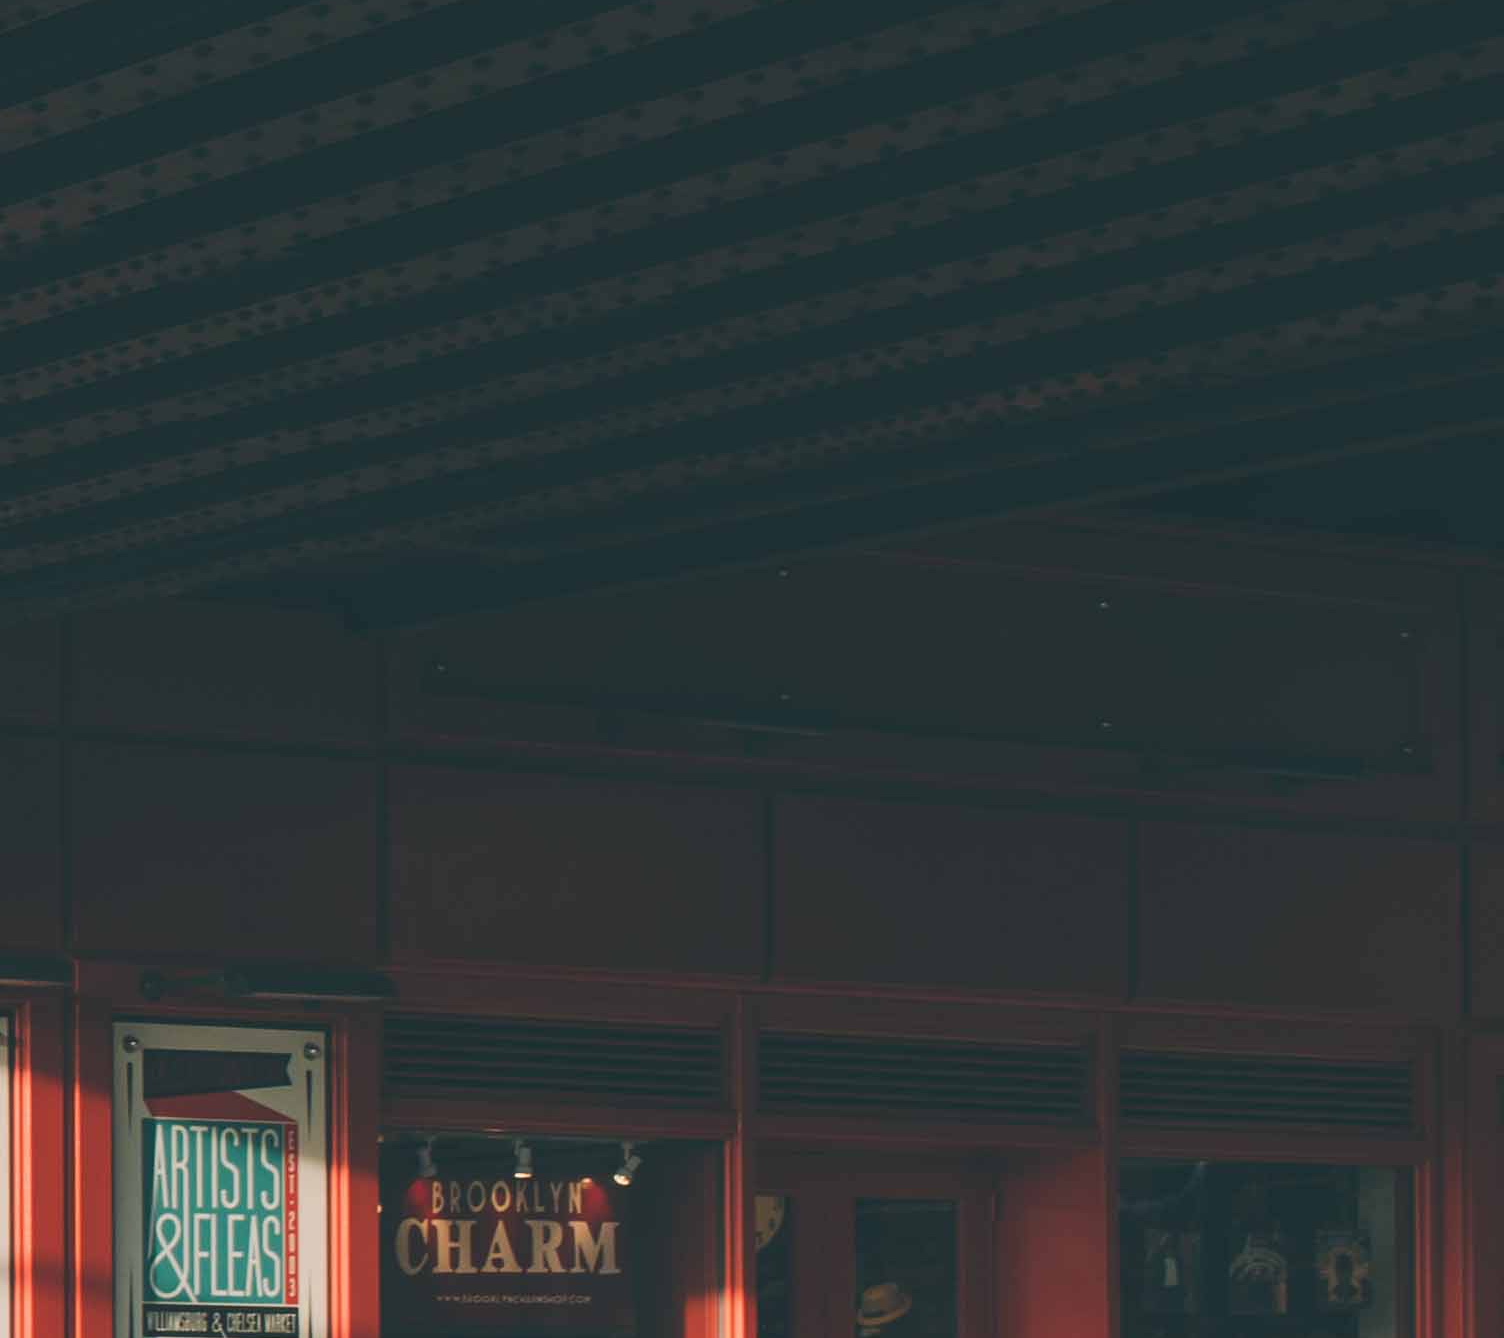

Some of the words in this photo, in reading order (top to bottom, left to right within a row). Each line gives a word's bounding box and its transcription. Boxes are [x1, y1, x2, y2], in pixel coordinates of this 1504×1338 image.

[148, 1124, 281, 1258] ARTISTS
[431, 1180, 583, 1214] BROOKLYN
[149, 1213, 198, 1303] &
[193, 1212, 281, 1298] FLEAS
[394, 1216, 622, 1276] CHARM
